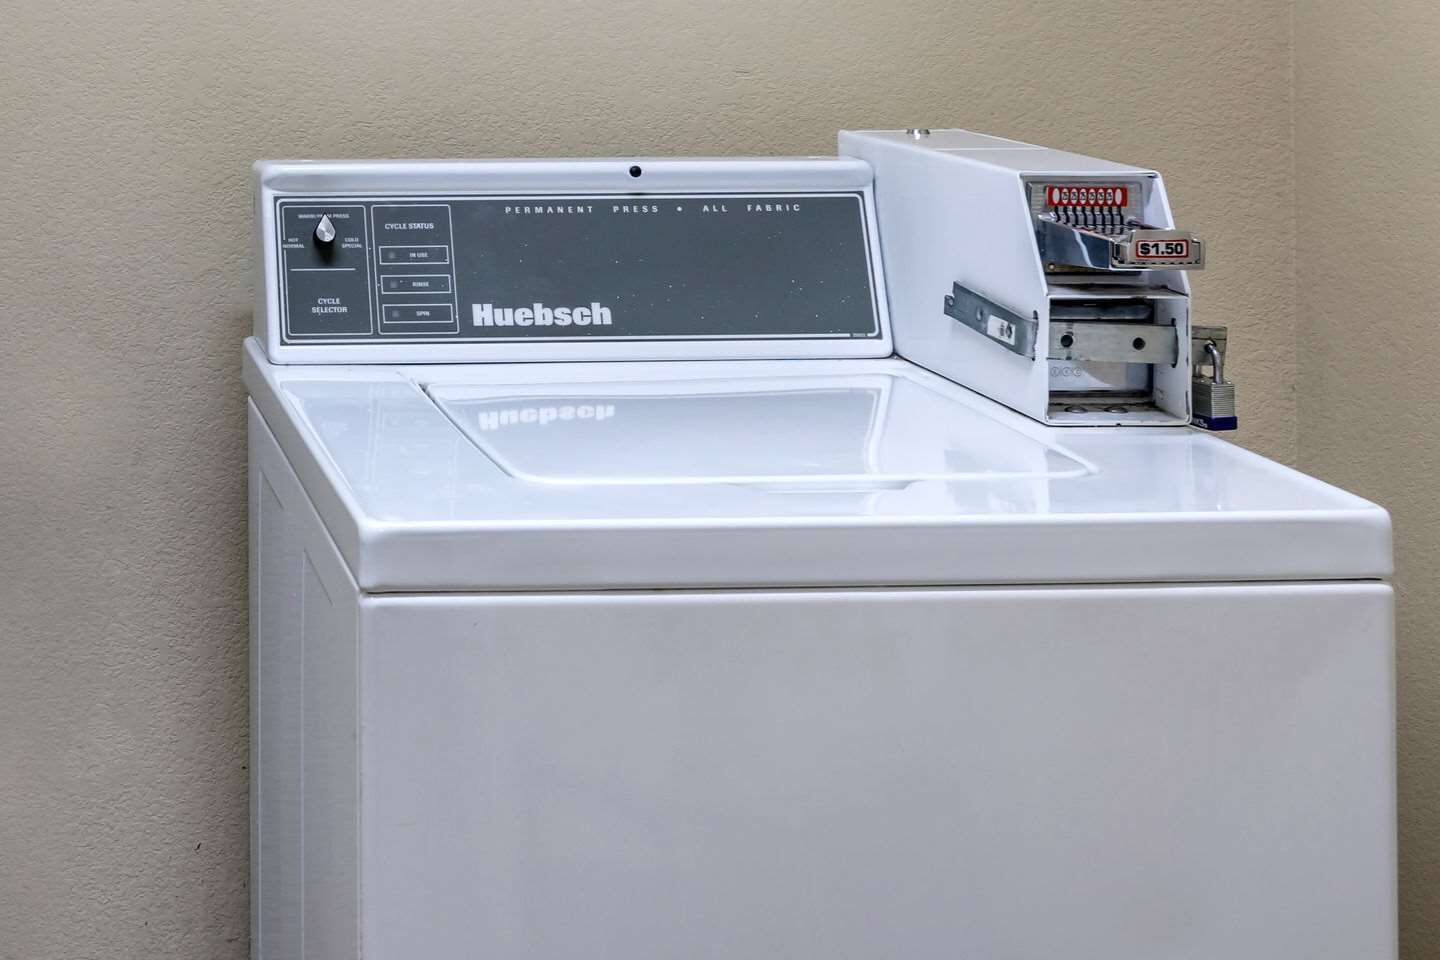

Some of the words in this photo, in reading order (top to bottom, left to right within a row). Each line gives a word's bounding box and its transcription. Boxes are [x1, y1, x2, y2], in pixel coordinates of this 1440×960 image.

[1139, 242, 1185, 257] $1.50
[317, 297, 340, 305] CYCLE
[311, 306, 348, 314] SELECTOR
[472, 302, 613, 327] Huebsch
